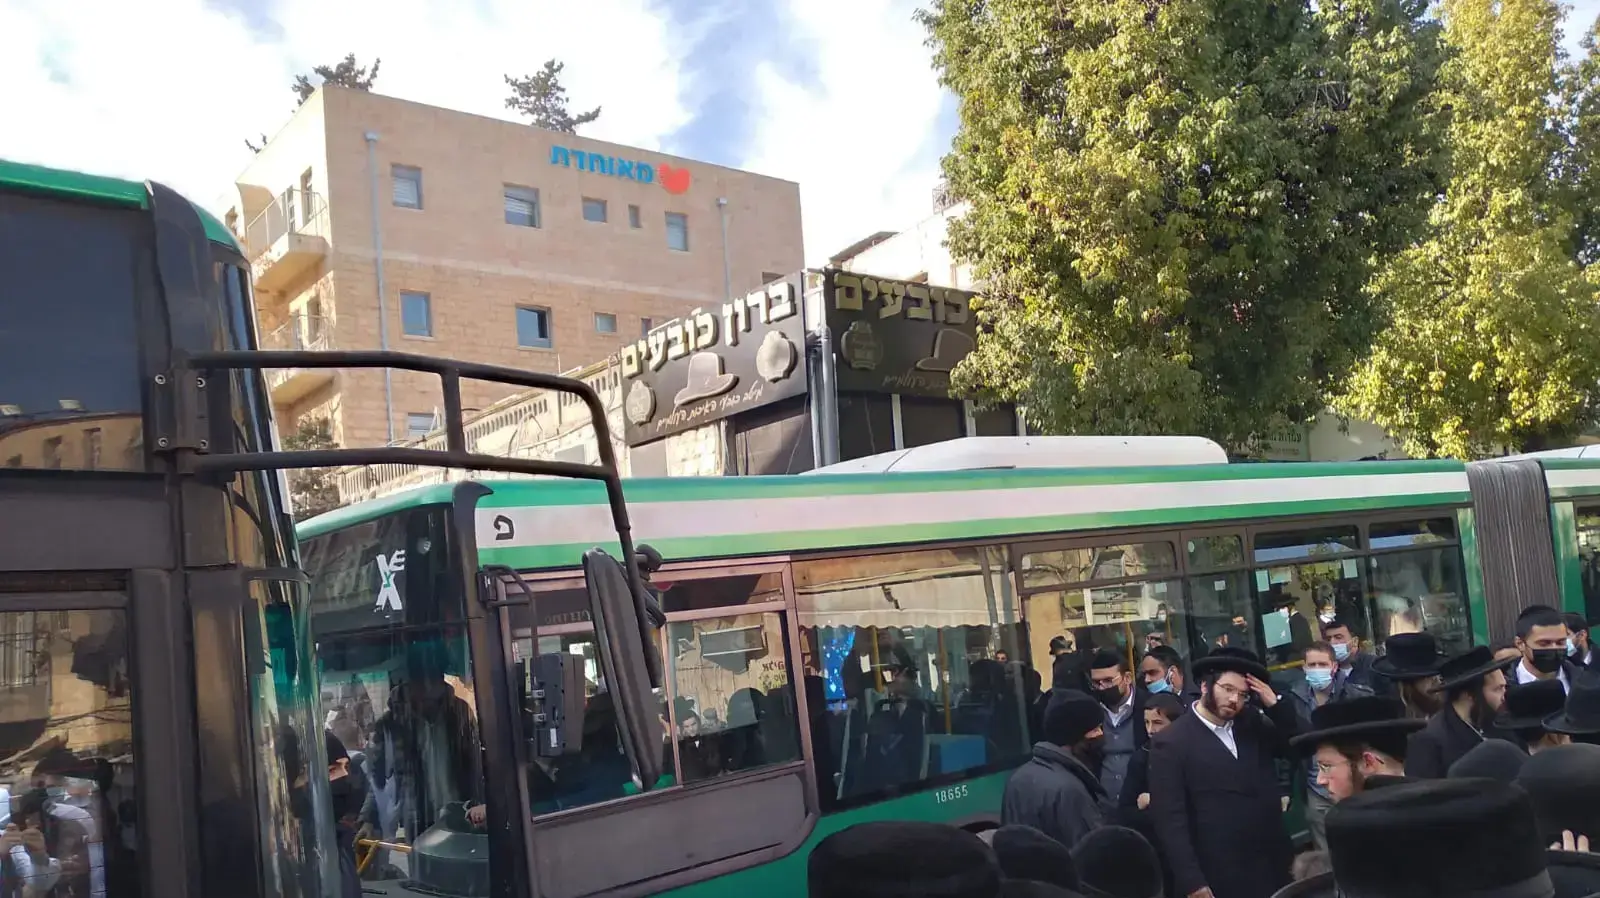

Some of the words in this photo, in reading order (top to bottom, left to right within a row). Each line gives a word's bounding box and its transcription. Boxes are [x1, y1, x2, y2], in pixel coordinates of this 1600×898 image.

[550, 144, 655, 184] מאוחדת
[722, 282, 796, 347] ברון
[835, 272, 969, 325] כובעים
[621, 308, 719, 378] כובעים
[493, 514, 515, 541] פ
[935, 784, 969, 804] 18655
